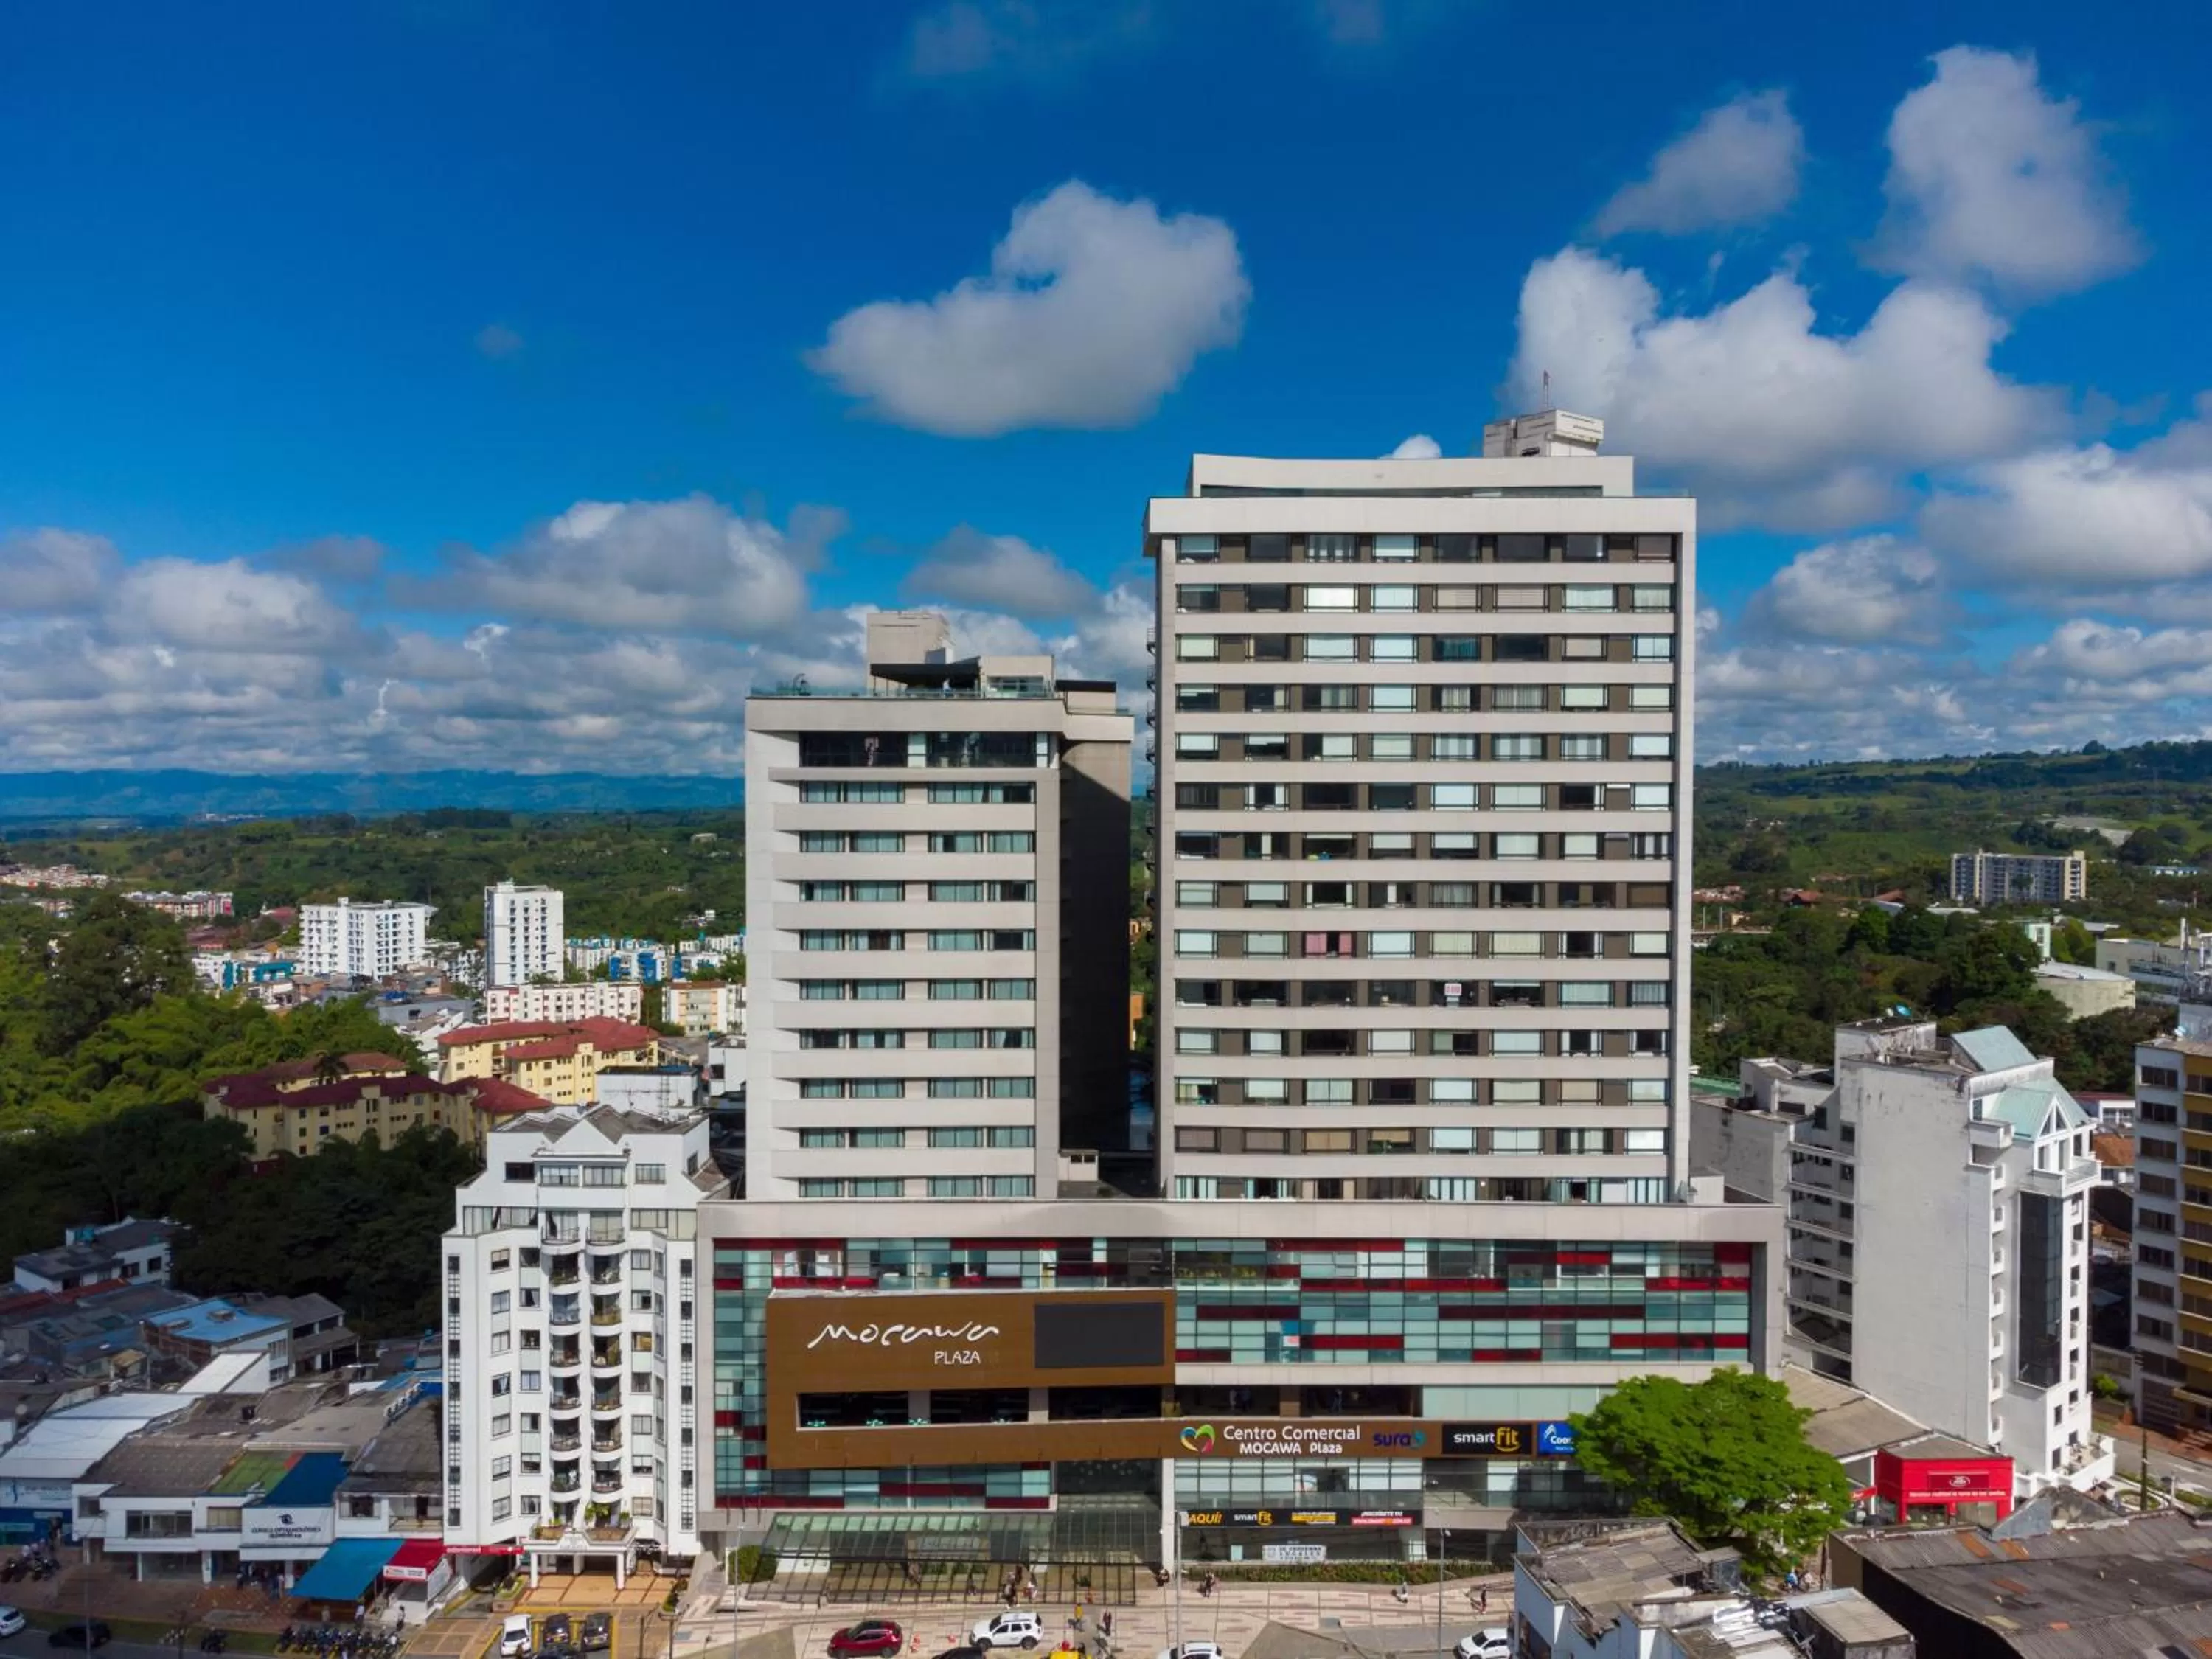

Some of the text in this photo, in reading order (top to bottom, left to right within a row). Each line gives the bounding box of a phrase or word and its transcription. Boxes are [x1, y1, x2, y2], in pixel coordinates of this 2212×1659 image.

[934, 1350, 981, 1365] PLAZA
[1223, 1425, 1360, 1440] Centro Comercial
[1239, 1442, 1343, 1455] MOCAWA Plaza
